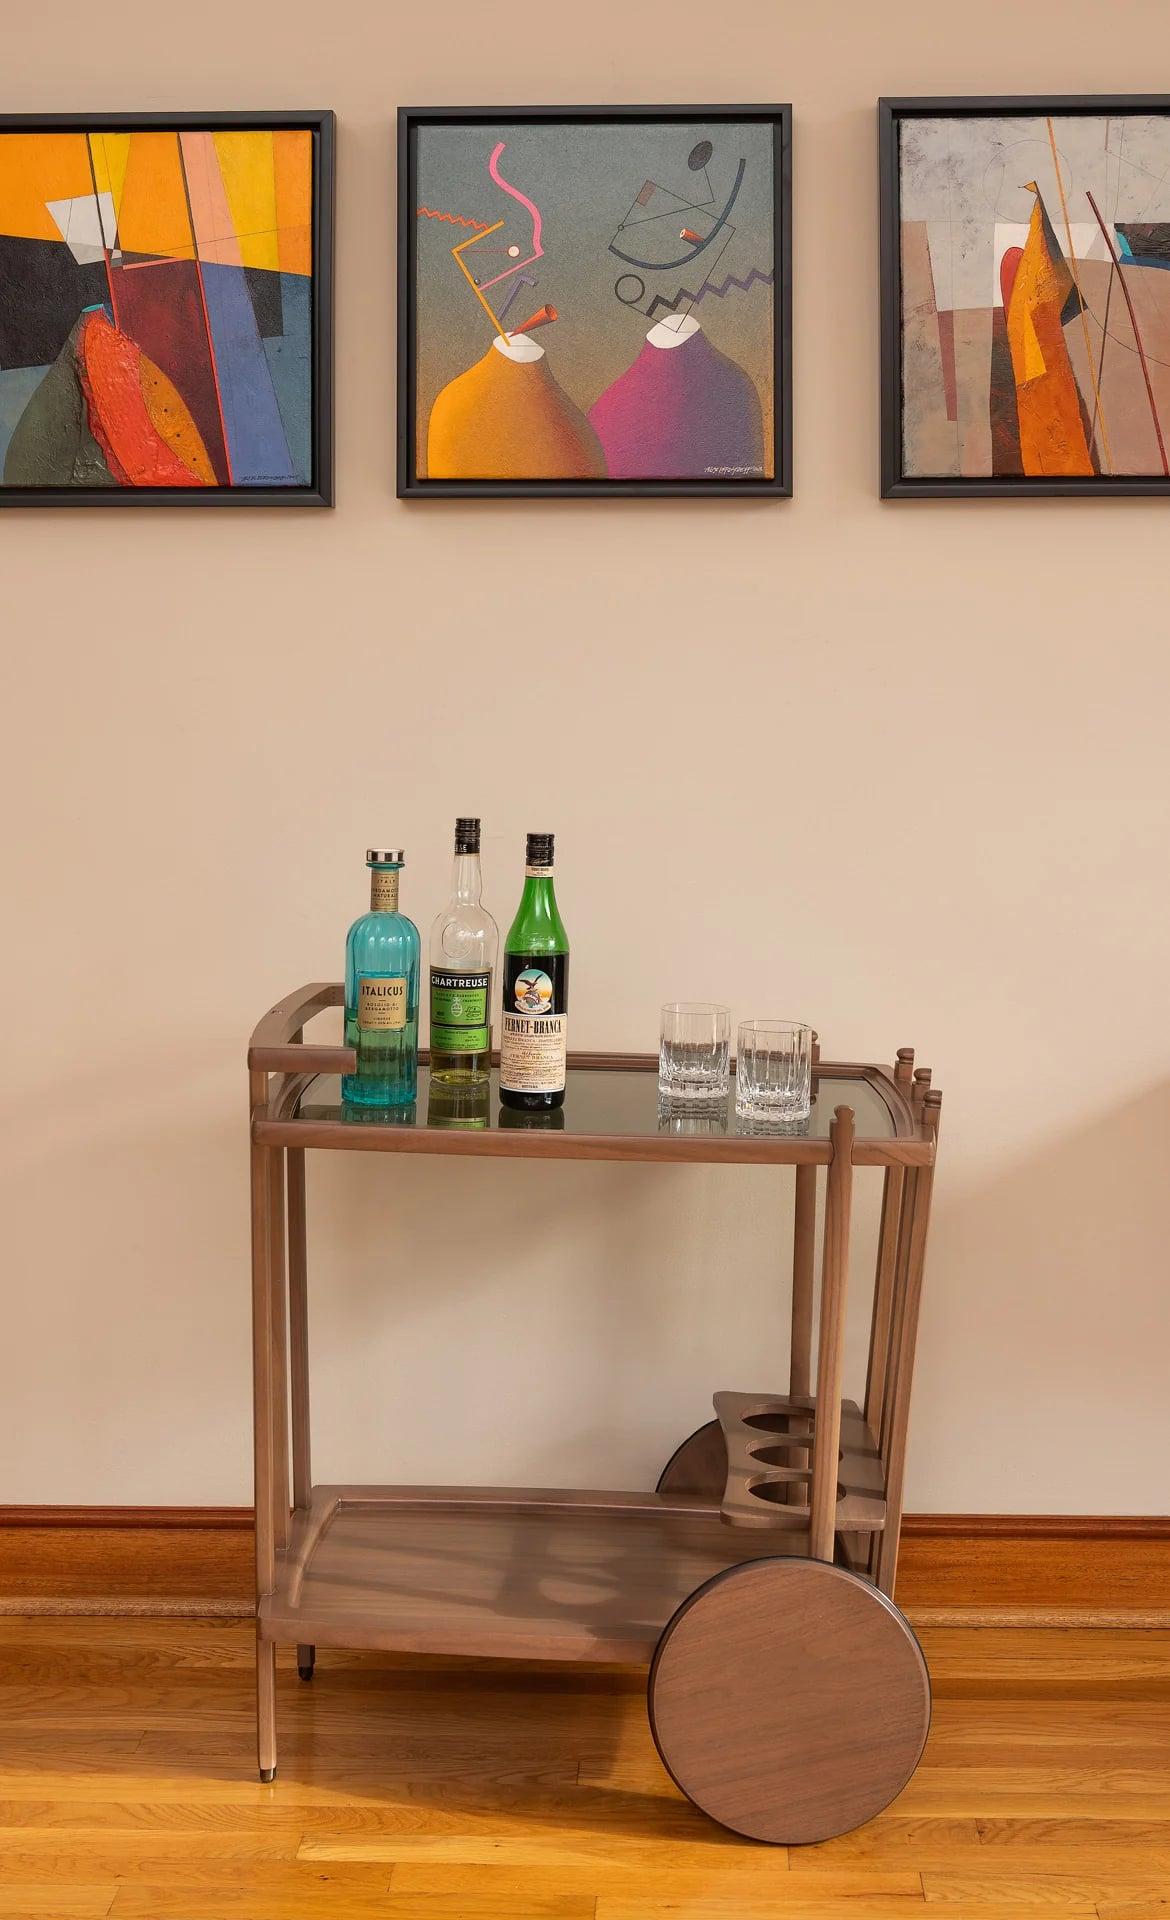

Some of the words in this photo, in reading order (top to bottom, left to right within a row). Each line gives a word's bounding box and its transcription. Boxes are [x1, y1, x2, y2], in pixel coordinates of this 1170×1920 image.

[431, 975, 488, 987] CHARTREUSE
[362, 985, 403, 996] ITALICUS
[504, 1017, 562, 1034] FERNET-BRANCA
